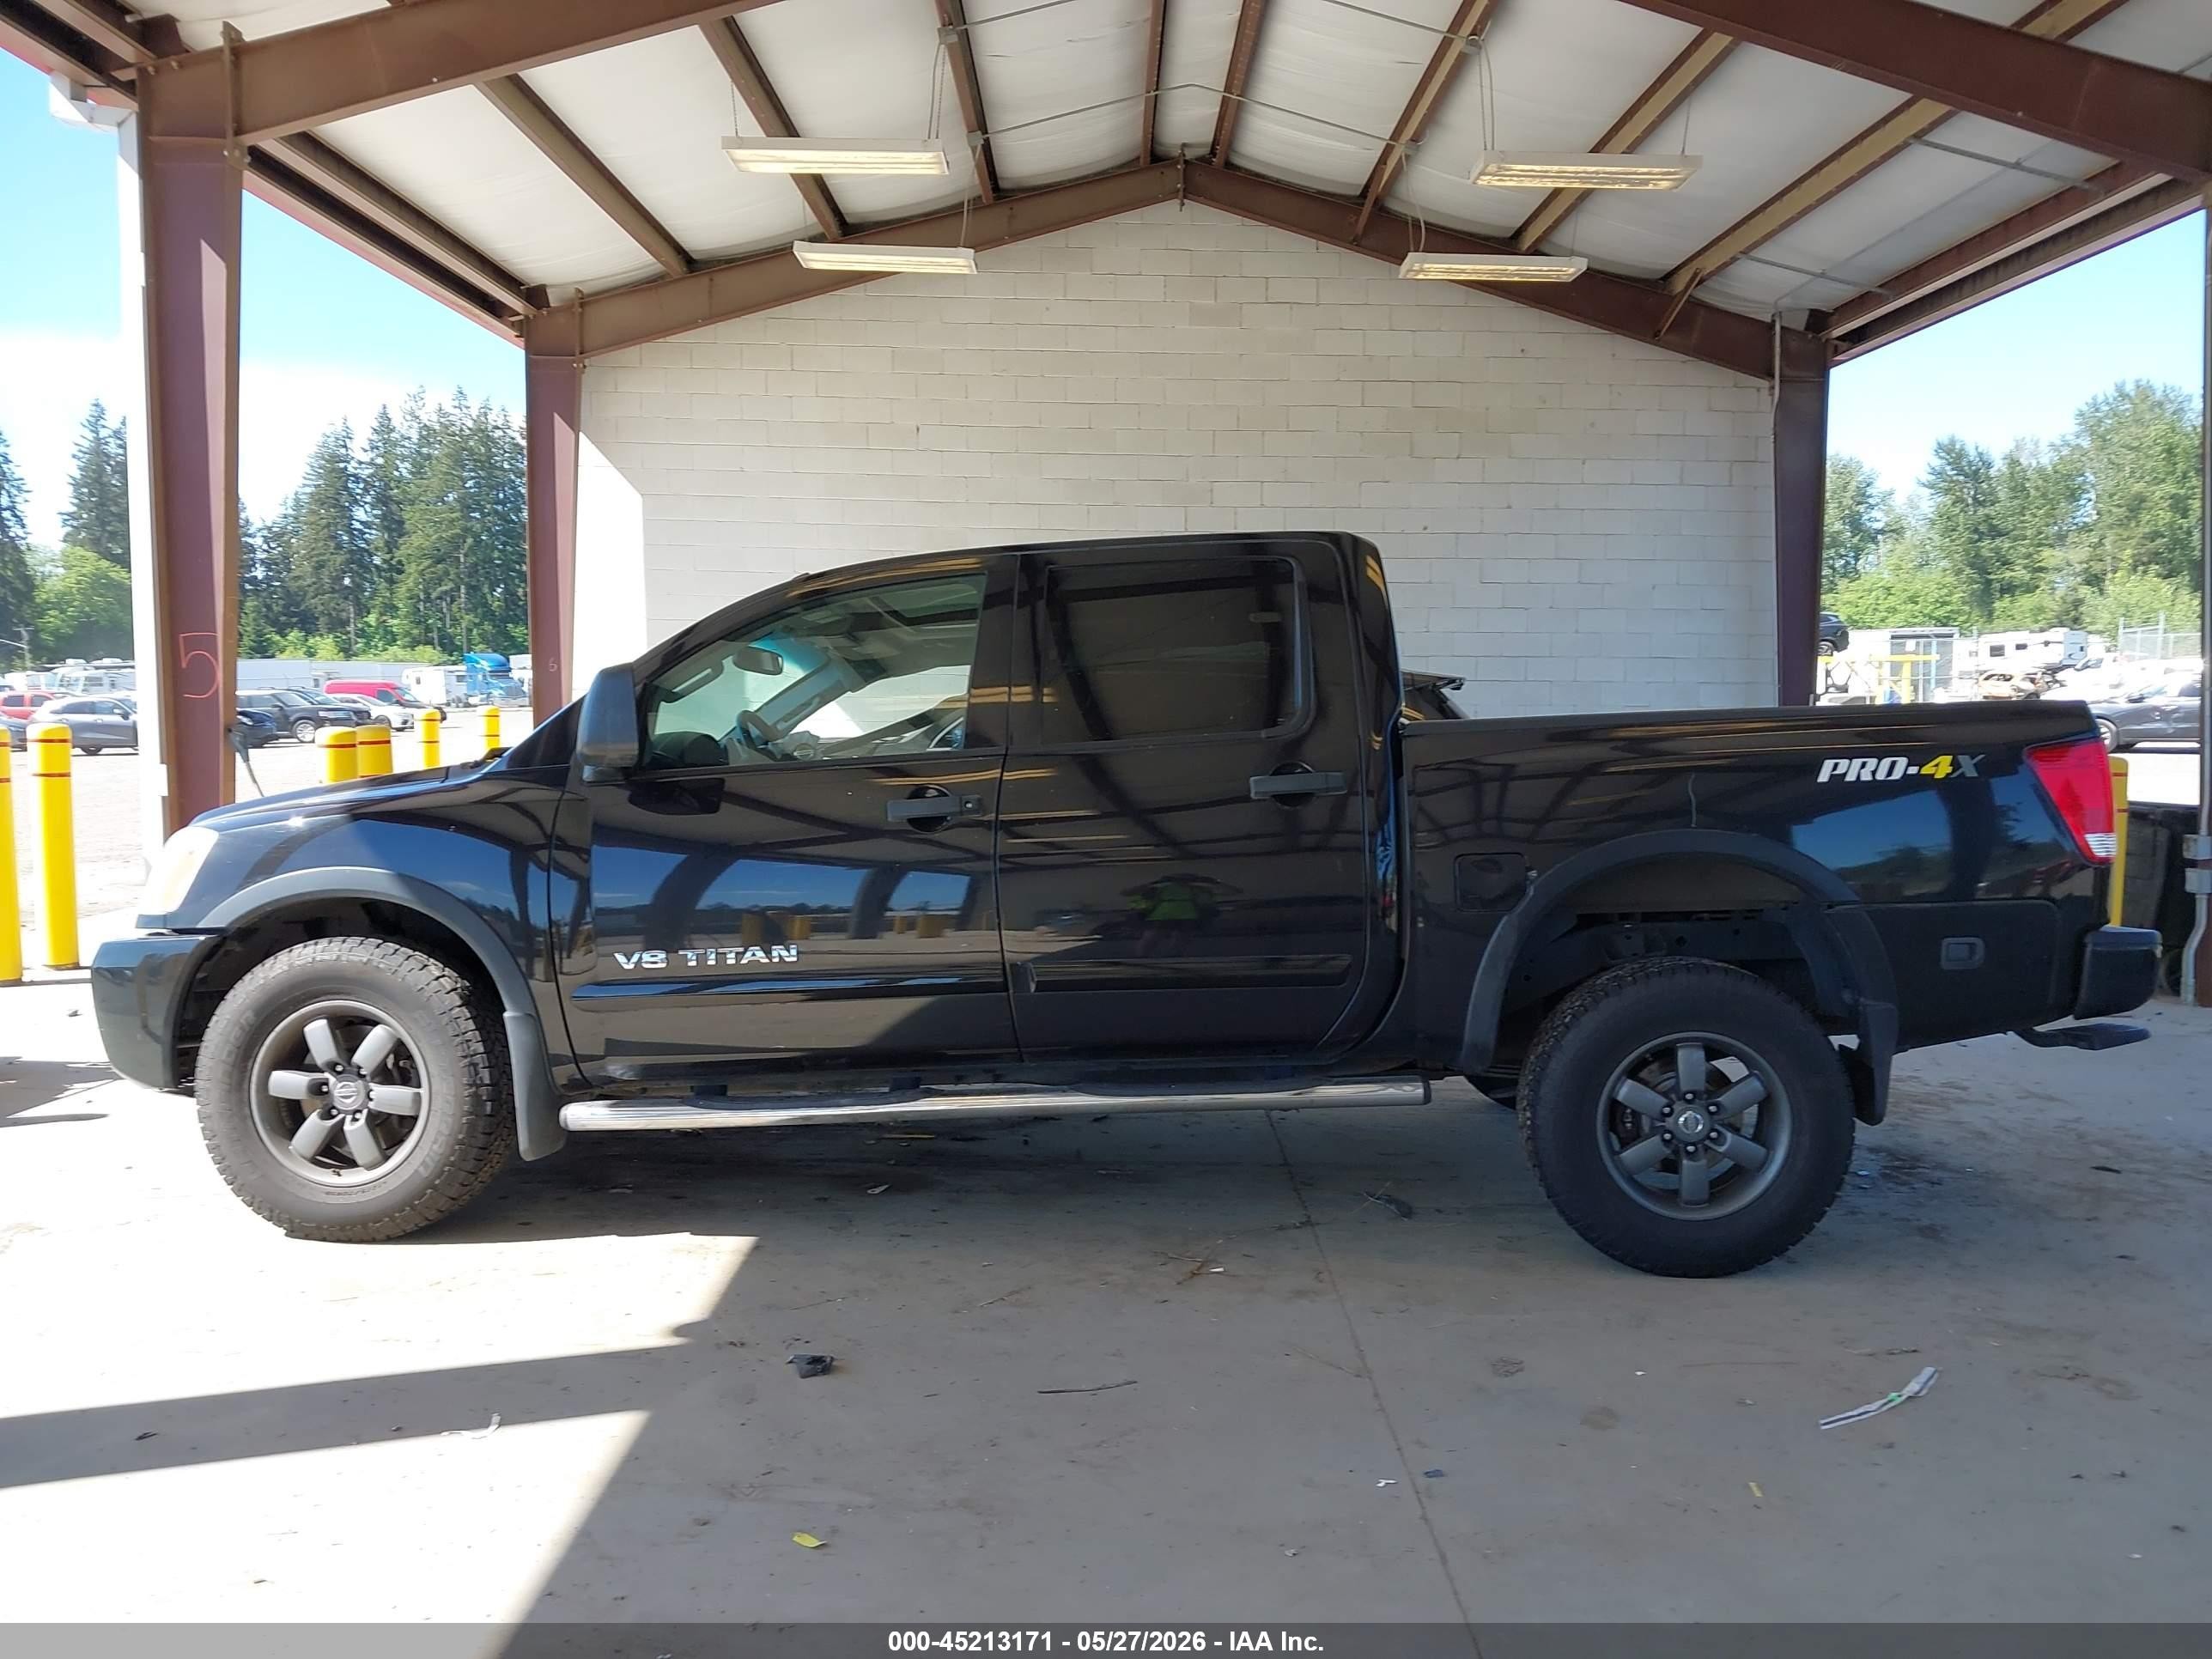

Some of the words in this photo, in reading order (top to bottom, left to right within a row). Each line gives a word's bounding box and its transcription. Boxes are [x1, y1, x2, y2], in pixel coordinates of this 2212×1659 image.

[178, 631, 222, 698] 5
[1816, 754, 1986, 783] PRO-4X
[613, 950, 668, 970] V8
[678, 944, 799, 967] TITAN
